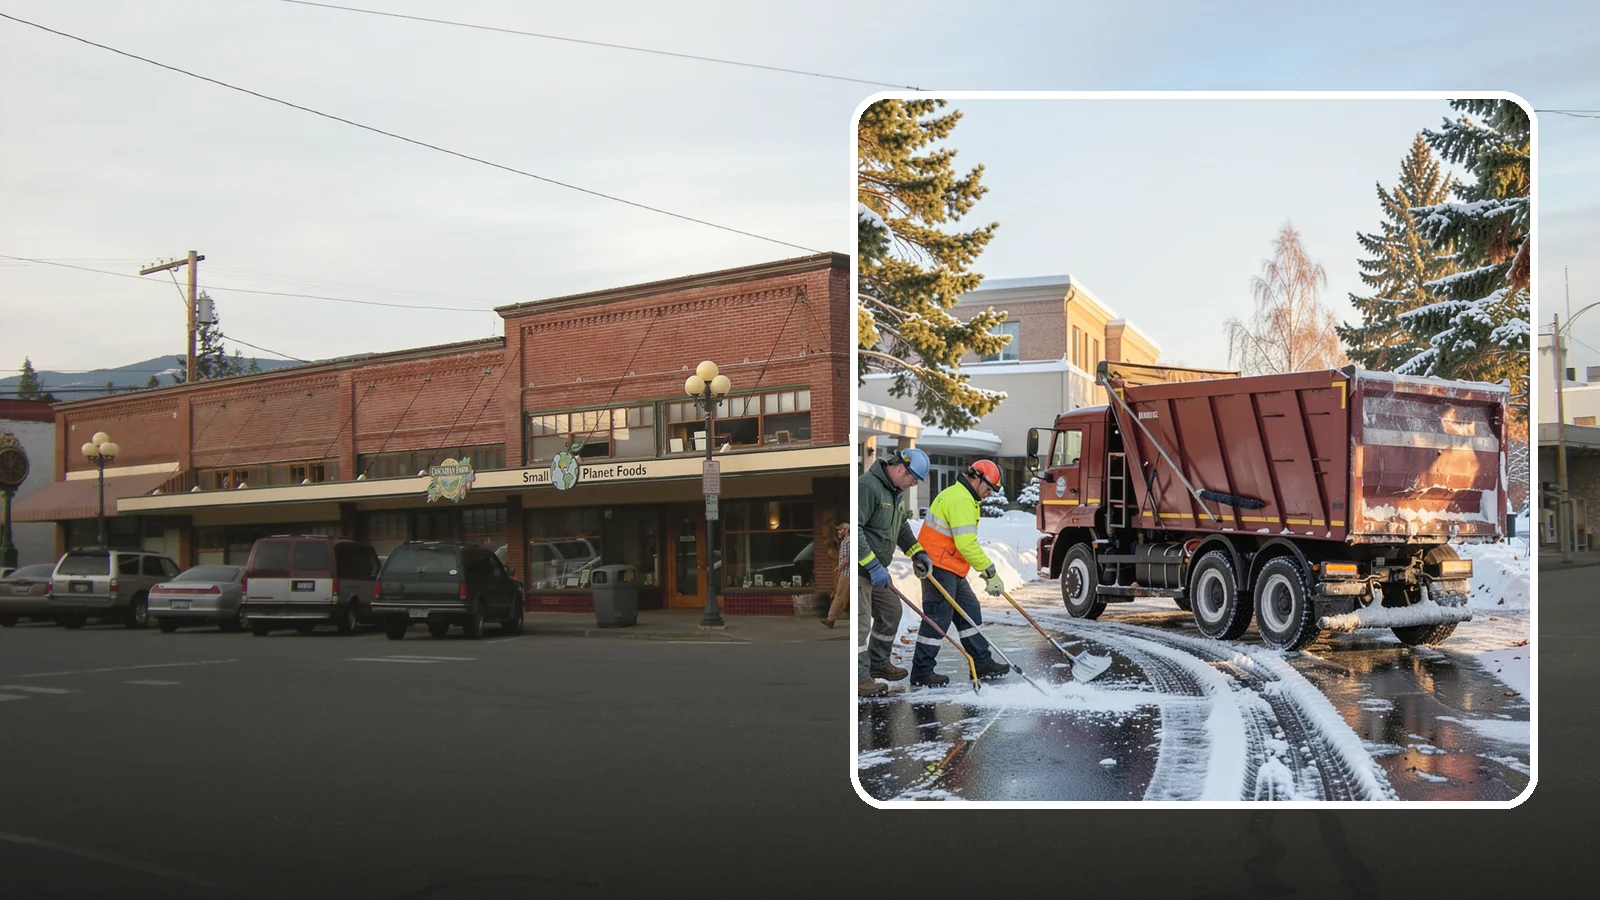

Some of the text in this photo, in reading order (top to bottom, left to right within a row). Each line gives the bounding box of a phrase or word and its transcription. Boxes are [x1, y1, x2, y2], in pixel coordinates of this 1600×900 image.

[523, 464, 647, 483] Small Planet Foods
